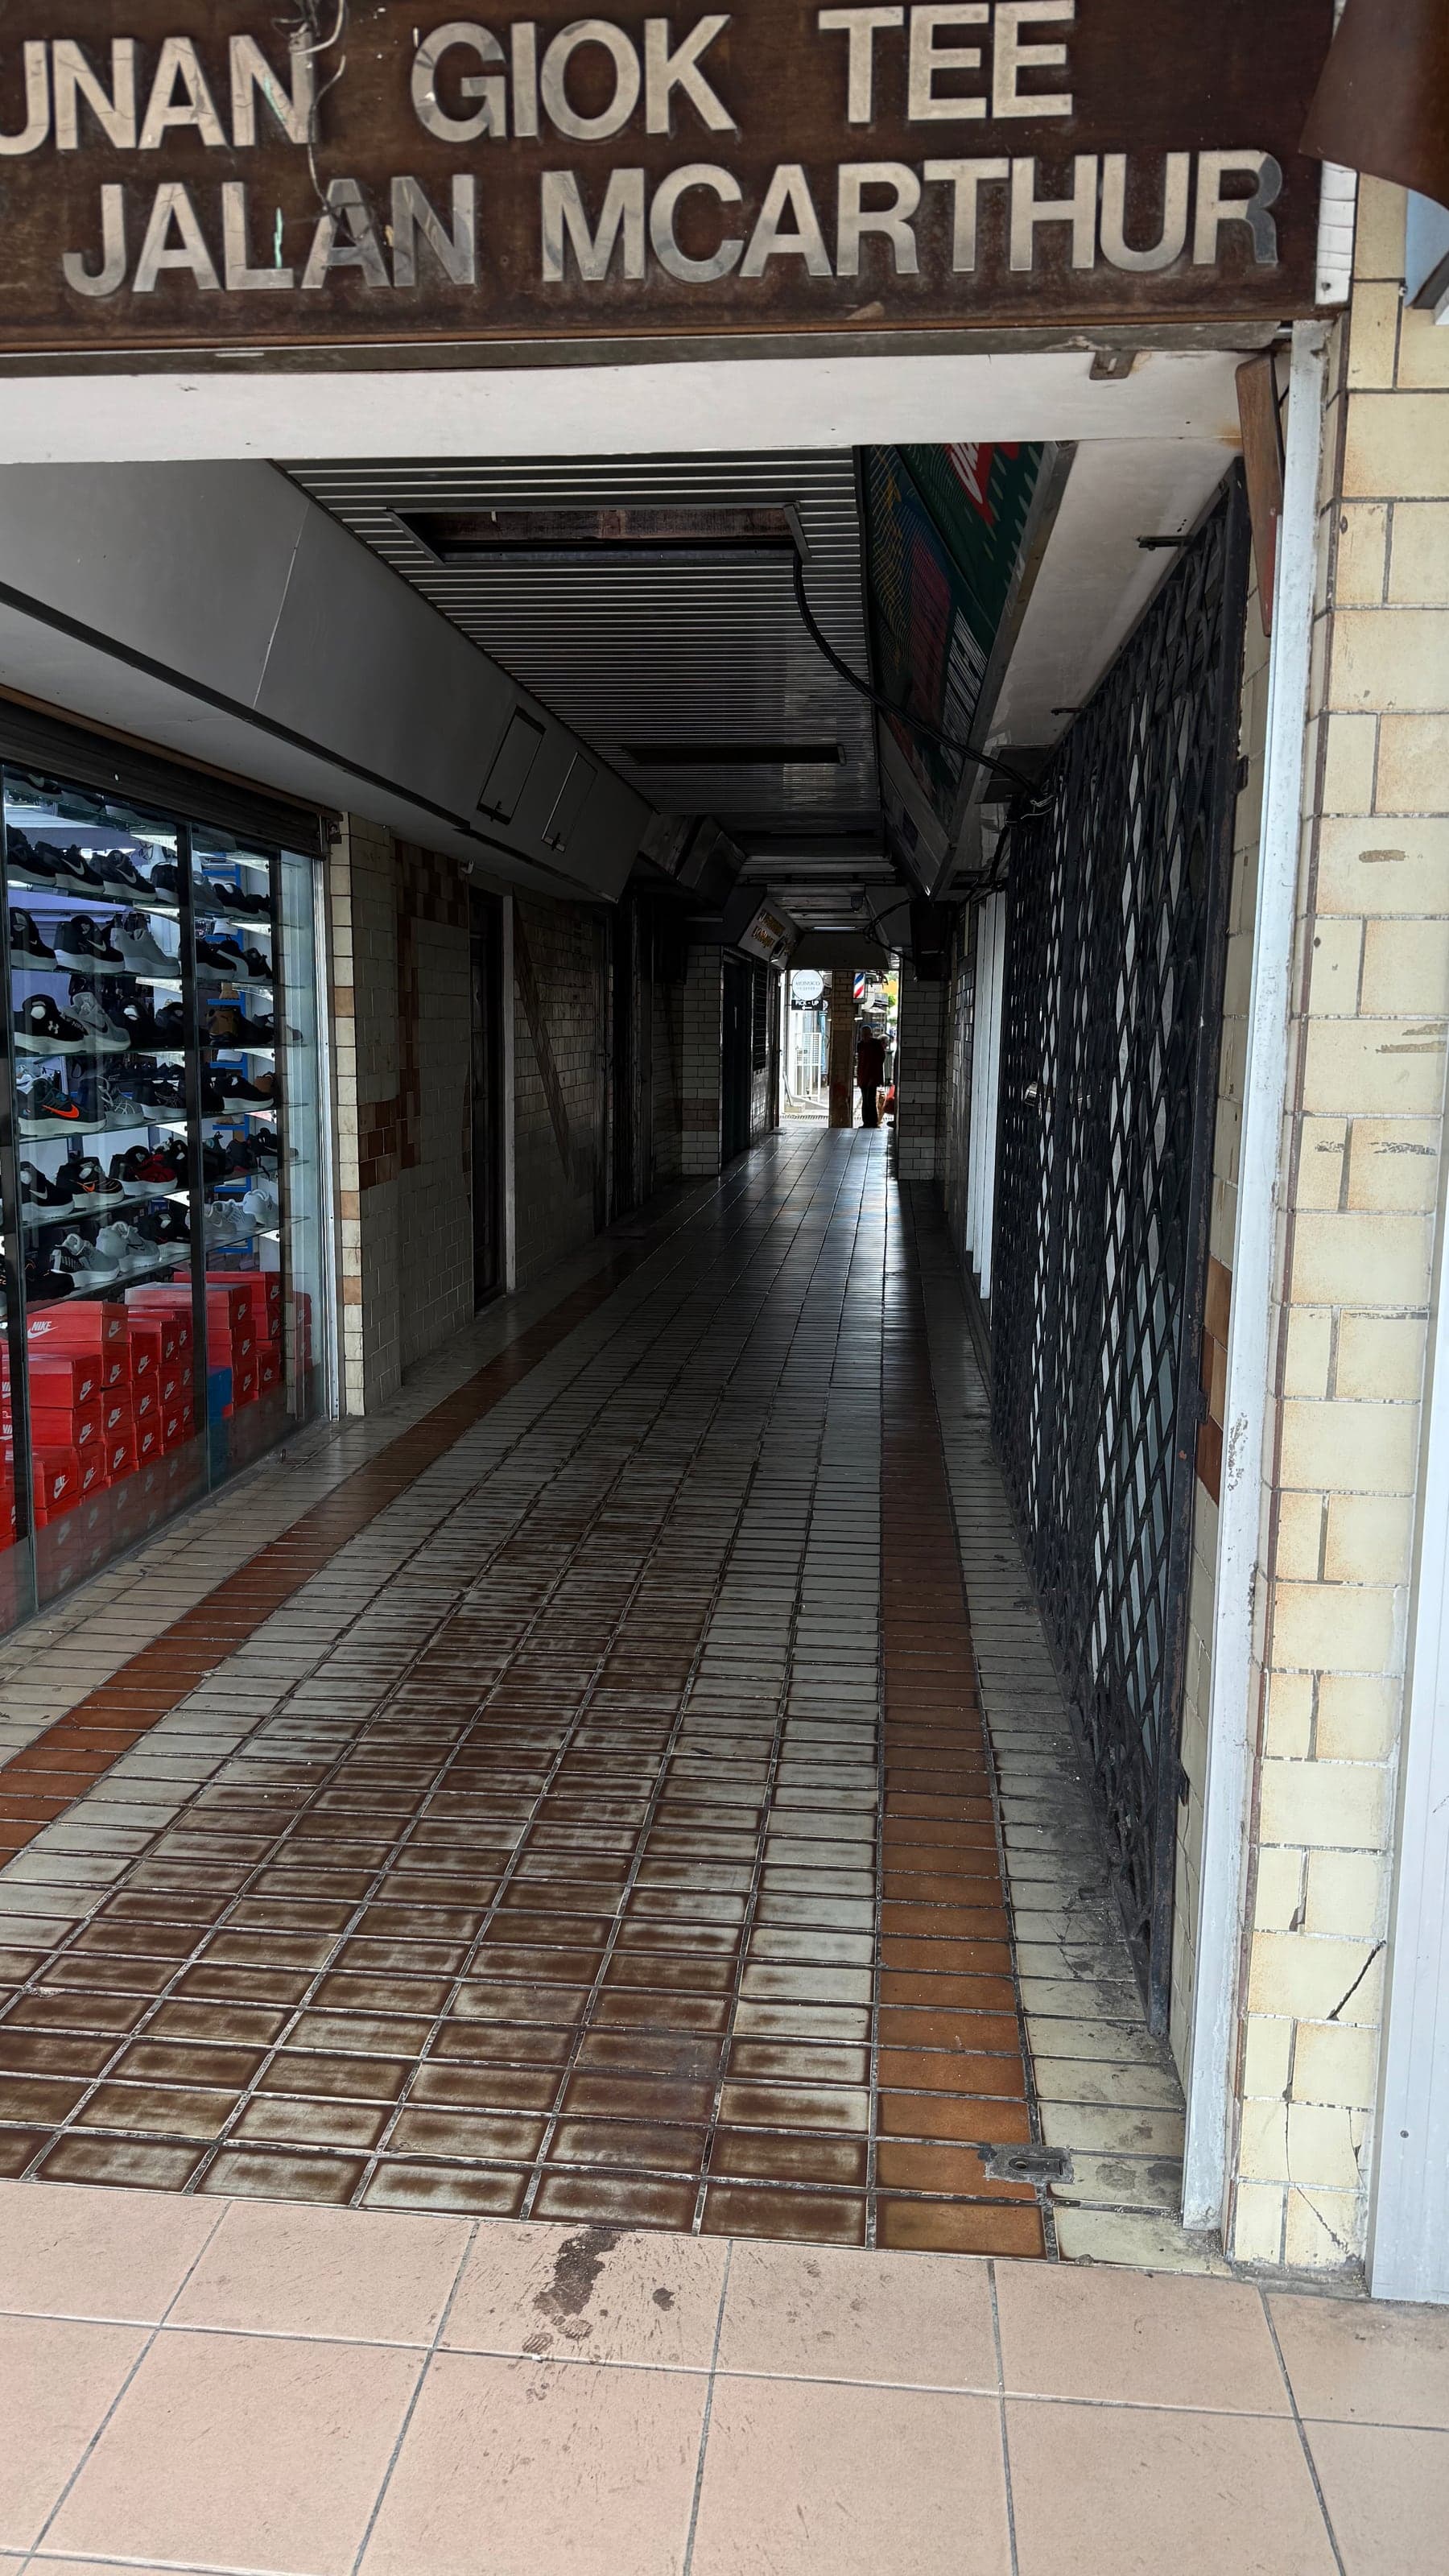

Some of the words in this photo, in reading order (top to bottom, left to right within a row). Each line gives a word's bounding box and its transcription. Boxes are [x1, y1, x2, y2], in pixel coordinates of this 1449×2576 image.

[410, 14, 738, 142] GIOK
[818, 1, 1075, 123] TEE
[62, 174, 475, 296] JALAN
[540, 150, 1283, 283] MCARTHUR
[31, 1321, 52, 1331] NIKE
